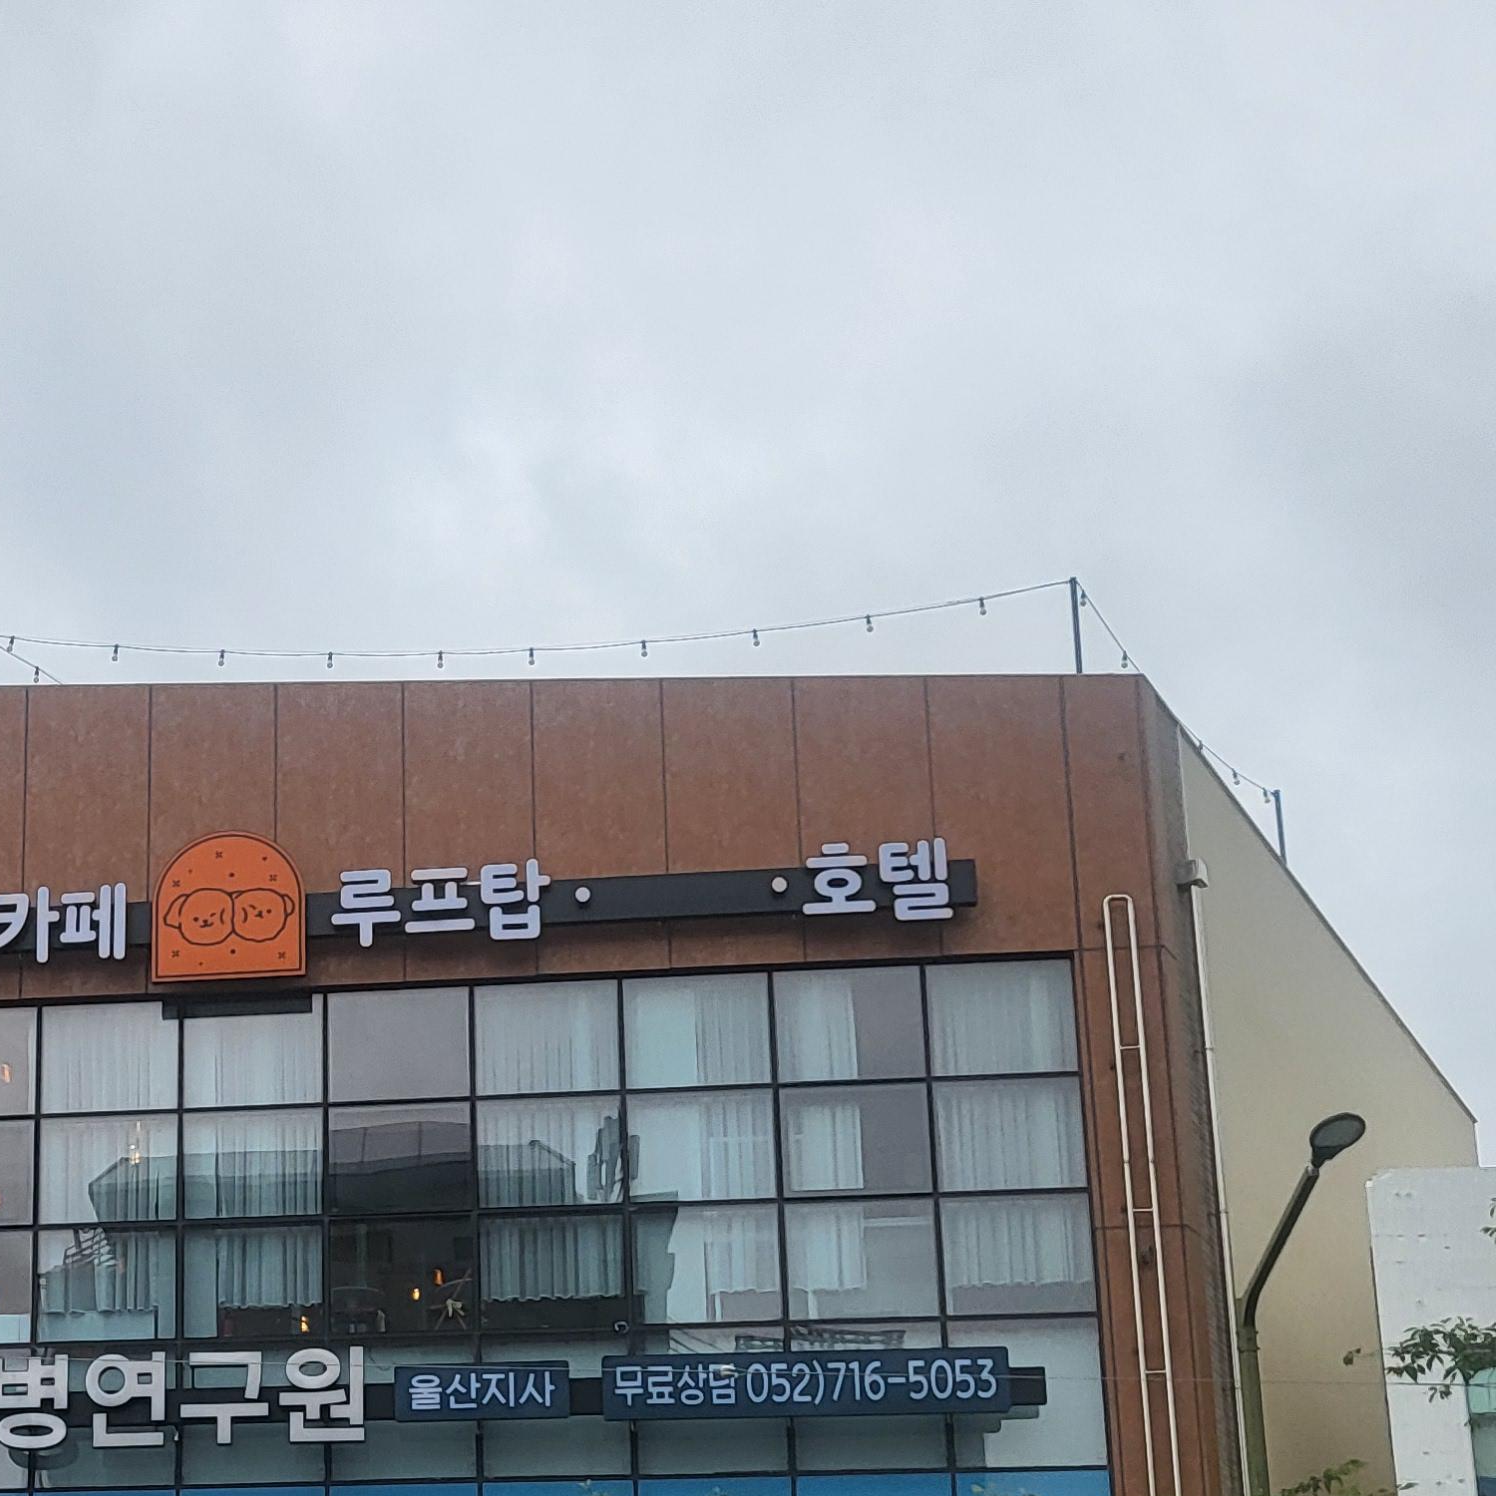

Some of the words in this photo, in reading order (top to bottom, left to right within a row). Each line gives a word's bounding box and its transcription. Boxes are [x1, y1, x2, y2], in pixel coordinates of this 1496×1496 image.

[408, 1371, 555, 1410] 울산지사
[614, 1363, 736, 1407] 무료상담
[745, 1358, 997, 1406] 052)716-5053
